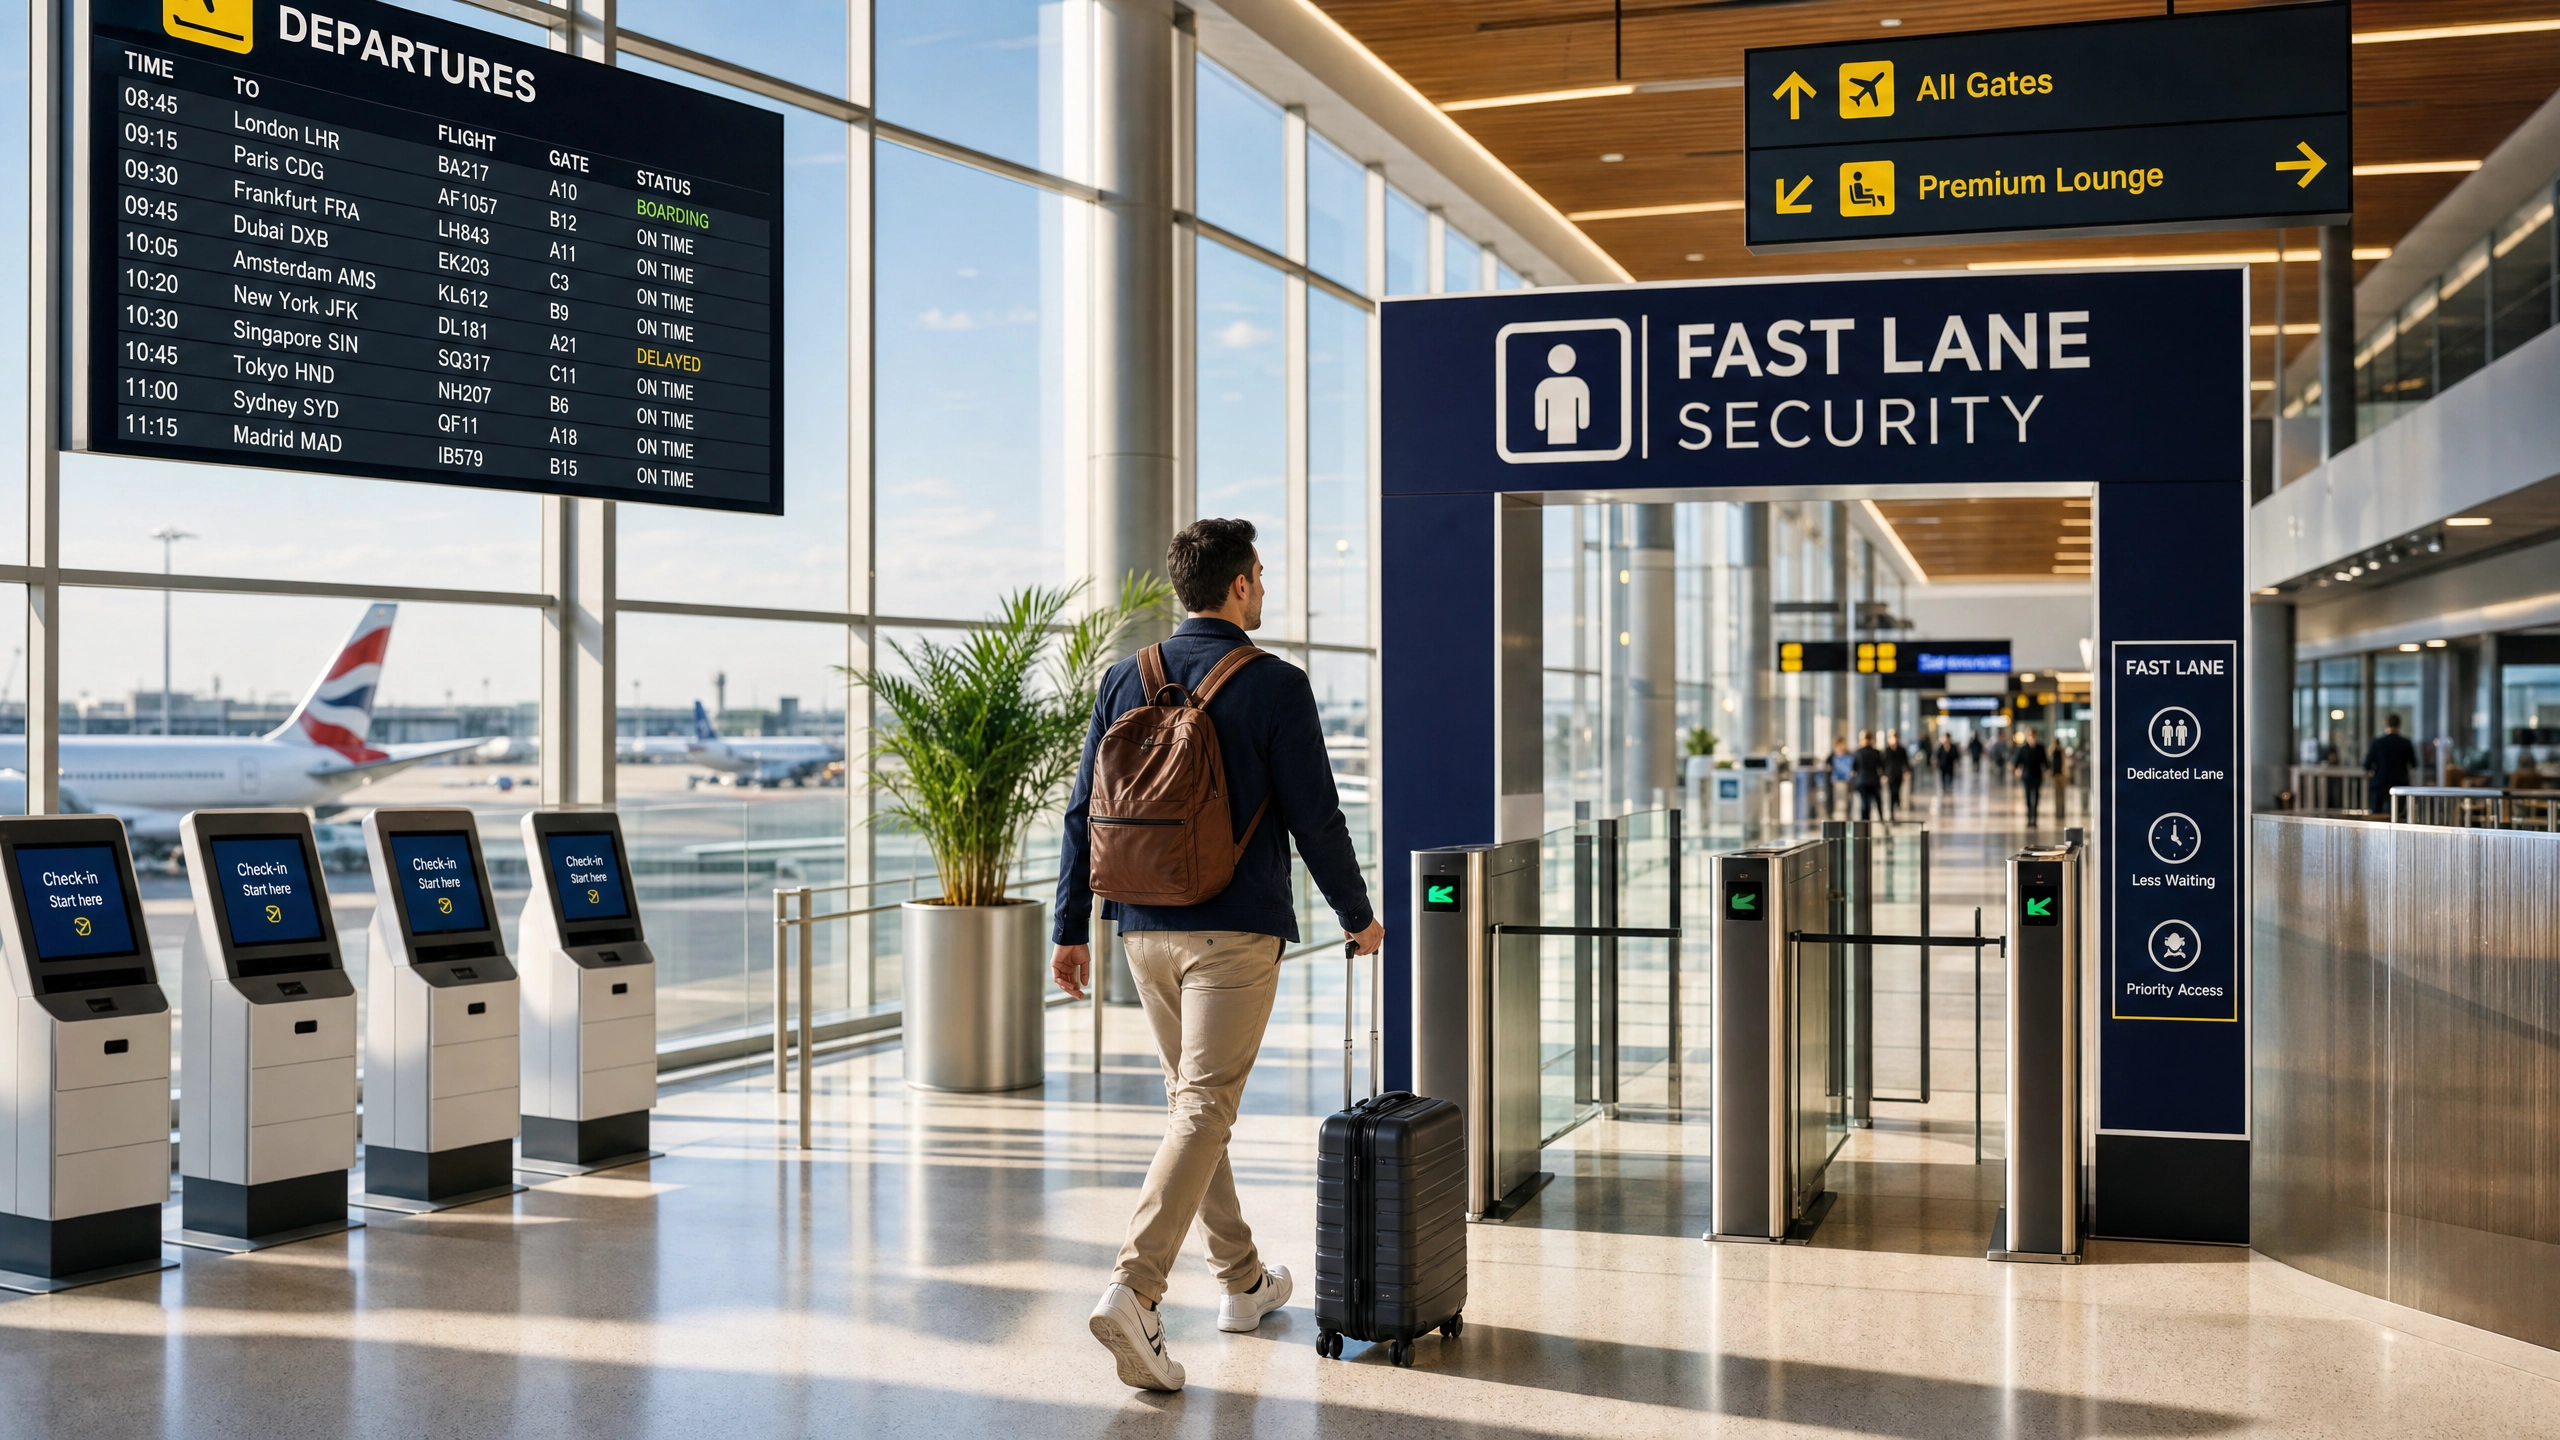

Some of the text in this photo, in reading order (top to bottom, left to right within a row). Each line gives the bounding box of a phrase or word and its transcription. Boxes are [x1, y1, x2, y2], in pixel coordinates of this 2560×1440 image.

[279, 5, 537, 104] DEPARTURES
[1916, 71, 2053, 102] All Gates
[124, 50, 691, 196] TIME TO FLIGHT GATE STATUS
[124, 86, 709, 229] 08:45 London LHR BA217 A10 BOARDING
[124, 122, 694, 256] 09:15 Paris CDG AF1057 B12 ON TIME
[1919, 167, 2164, 200] Premium Lounge
[125, 158, 694, 285] 09:30 Frankfurt FRA LH843 A11 ON TIME
[124, 194, 694, 314] 09:45 Dubai DXB EK203 C3 ON TIME
[126, 231, 694, 343] 10:05 Amsterdam AMS KL612 B9 ON TIME
[126, 268, 701, 373] 10:20 New York JFK DL181 A21 DELAYED
[126, 304, 694, 401] 10:30 Singapore SIN SQ317 C11 ON TIME
[1678, 310, 2090, 380] FAST LANE
[125, 340, 694, 431] 10:45 Tokyo HND NH207 B6 ON TIME
[126, 377, 694, 460] 11:00 Sydney SYD QF11 A18 ON TIME
[1678, 394, 2044, 451] SECURITY
[126, 413, 694, 489] 11:15 Madrid MAD IB579 B15 ON TIME
[2126, 659, 2224, 676] FAST LANE
[2127, 767, 2224, 780] Dedicated Lane
[42, 870, 99, 887] Check-in
[237, 861, 288, 877] Check-in
[412, 856, 457, 871] Check-in
[418, 876, 461, 890] Start here
[565, 855, 604, 868] Check-in
[570, 872, 608, 884] Start here
[2132, 873, 2216, 890] Less Waiting
[49, 893, 103, 908] Start here
[242, 882, 292, 897] Start here
[2126, 982, 2224, 999] Priority Access
